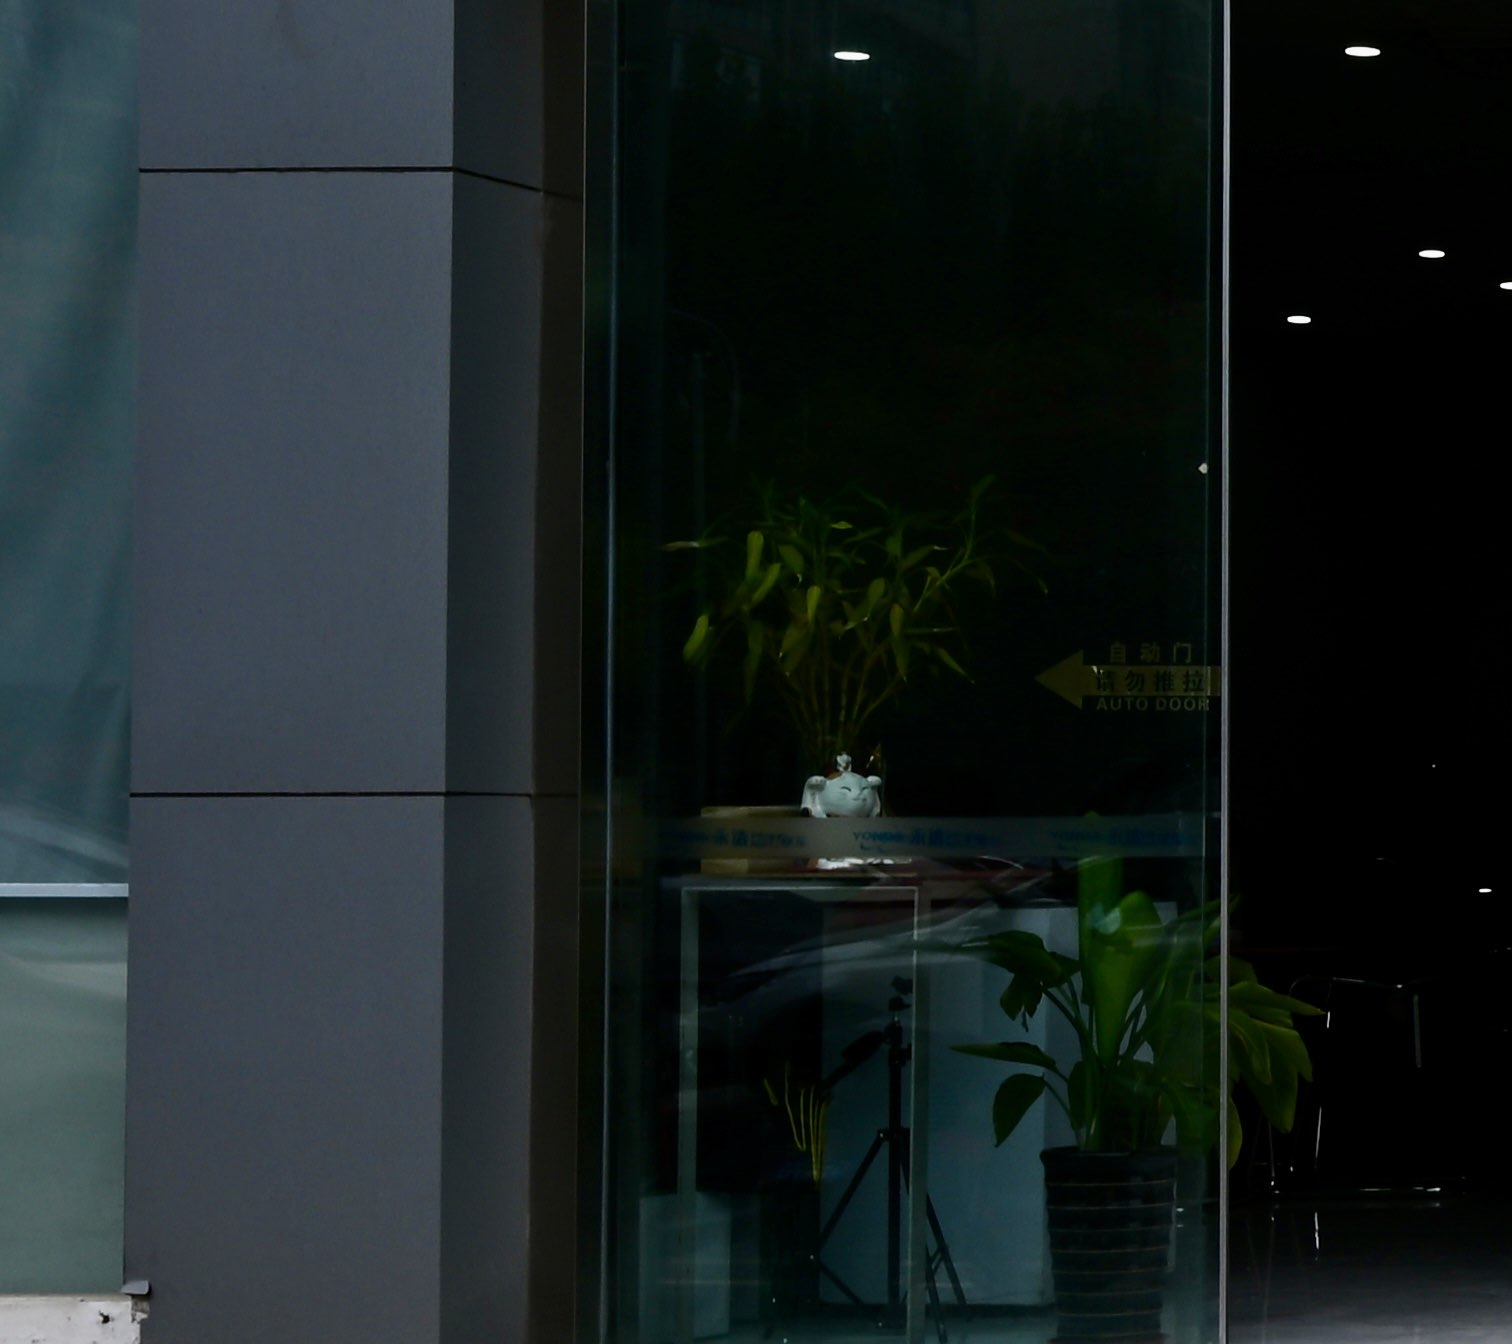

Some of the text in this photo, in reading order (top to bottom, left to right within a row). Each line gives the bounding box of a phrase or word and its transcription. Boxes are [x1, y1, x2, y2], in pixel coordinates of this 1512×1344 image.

[1109, 640, 1192, 664] 自动门
[1096, 697, 1210, 711] AUTO DOOR
